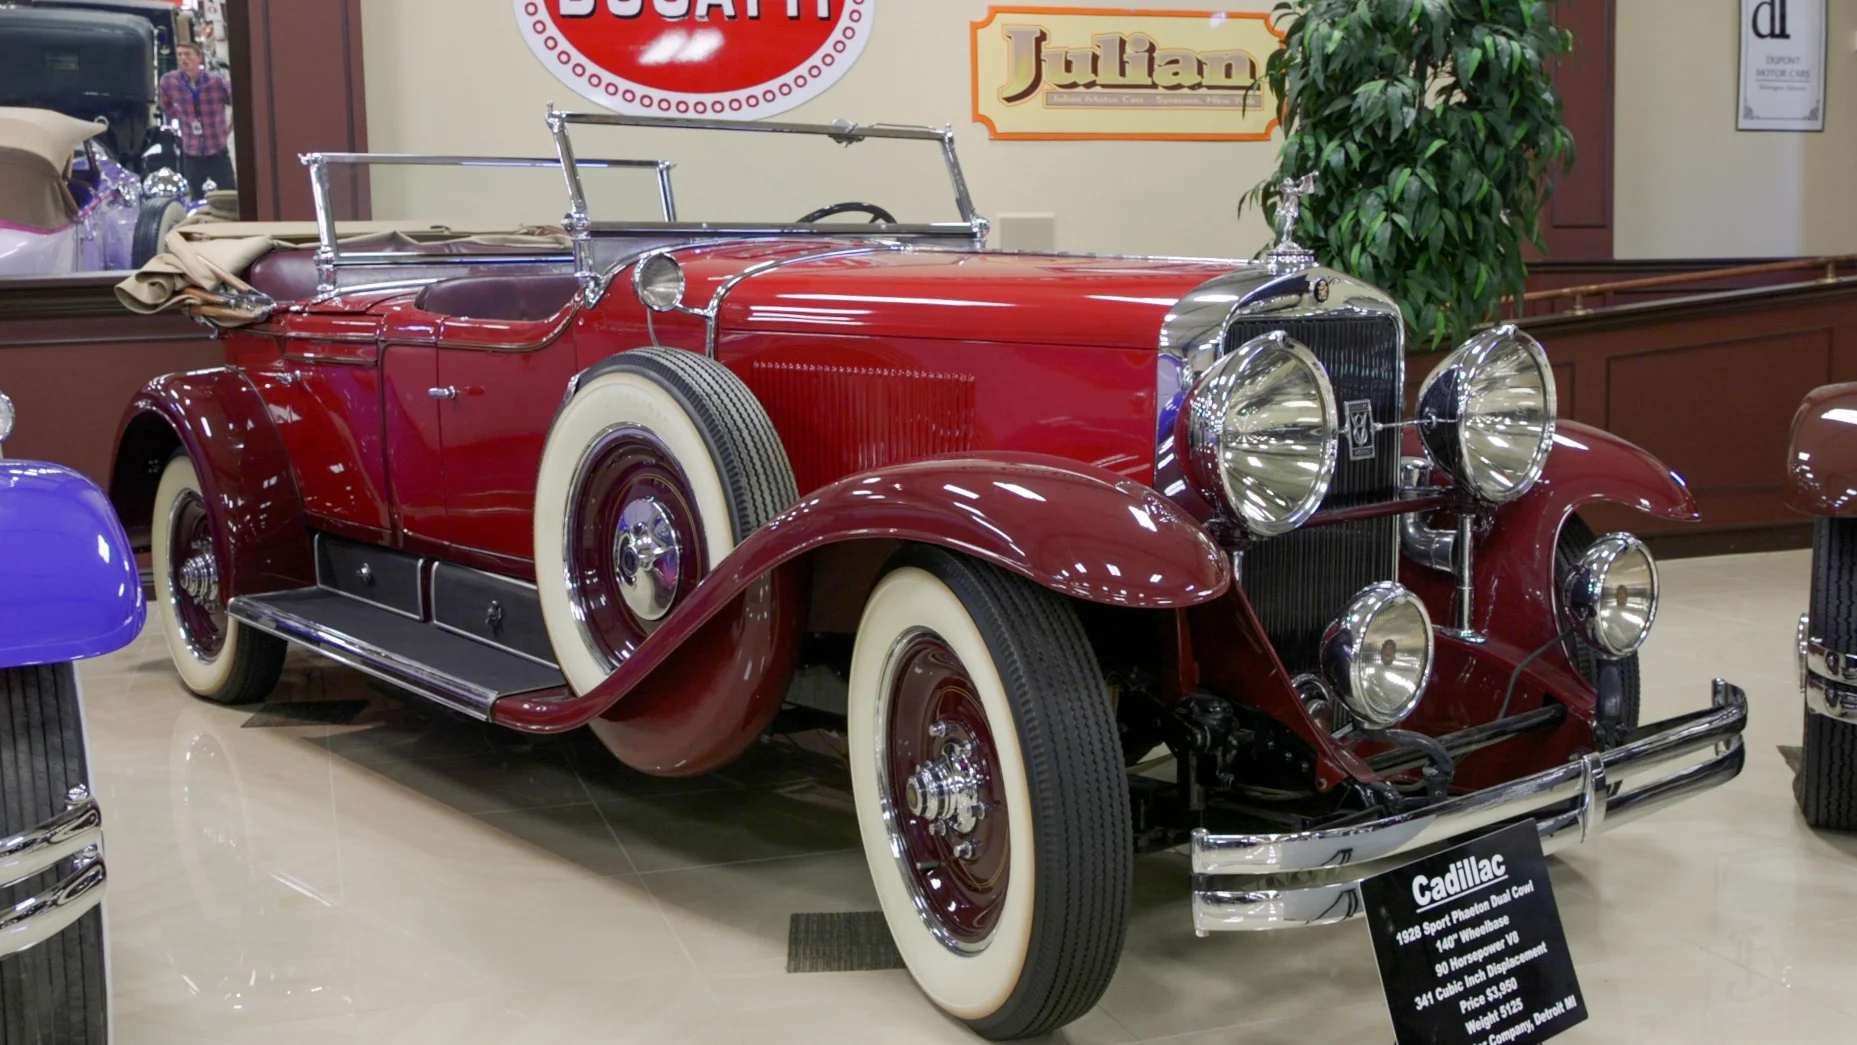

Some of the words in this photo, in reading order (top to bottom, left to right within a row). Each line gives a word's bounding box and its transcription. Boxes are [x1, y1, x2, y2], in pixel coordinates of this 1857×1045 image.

[1001, 28, 1261, 103] Julian
[1756, 69, 1787, 78] MOTOR
[1788, 70, 1810, 78] CARS
[1412, 854, 1506, 906] Cadillac
[1396, 925, 1422, 946] 1928
[1423, 915, 1451, 937] Sport
[1451, 900, 1490, 925] Phaeton
[1490, 889, 1511, 908] Dual
[1511, 880, 1534, 899] Cowl
[1435, 934, 1458, 952] 140"
[1459, 915, 1510, 944] Wheelbase
[1414, 993, 1435, 1011] 341
[1435, 980, 1464, 1001] Cubic
[1464, 970, 1486, 987] Inch
[1486, 941, 1548, 978] Displacement
[1435, 962, 1449, 977] 90
[1449, 939, 1506, 972] Horsepower
[1505, 931, 1520, 946] V8
[1459, 997, 1486, 1014] Price
[1486, 977, 1518, 1002] $3,950
[1465, 1011, 1500, 1035] Weight
[1500, 997, 1524, 1018] 5125
[1488, 1019, 1535, 1045] Company,
[1533, 1001, 1565, 1026] Detroit
[1564, 995, 1577, 1011] MI
